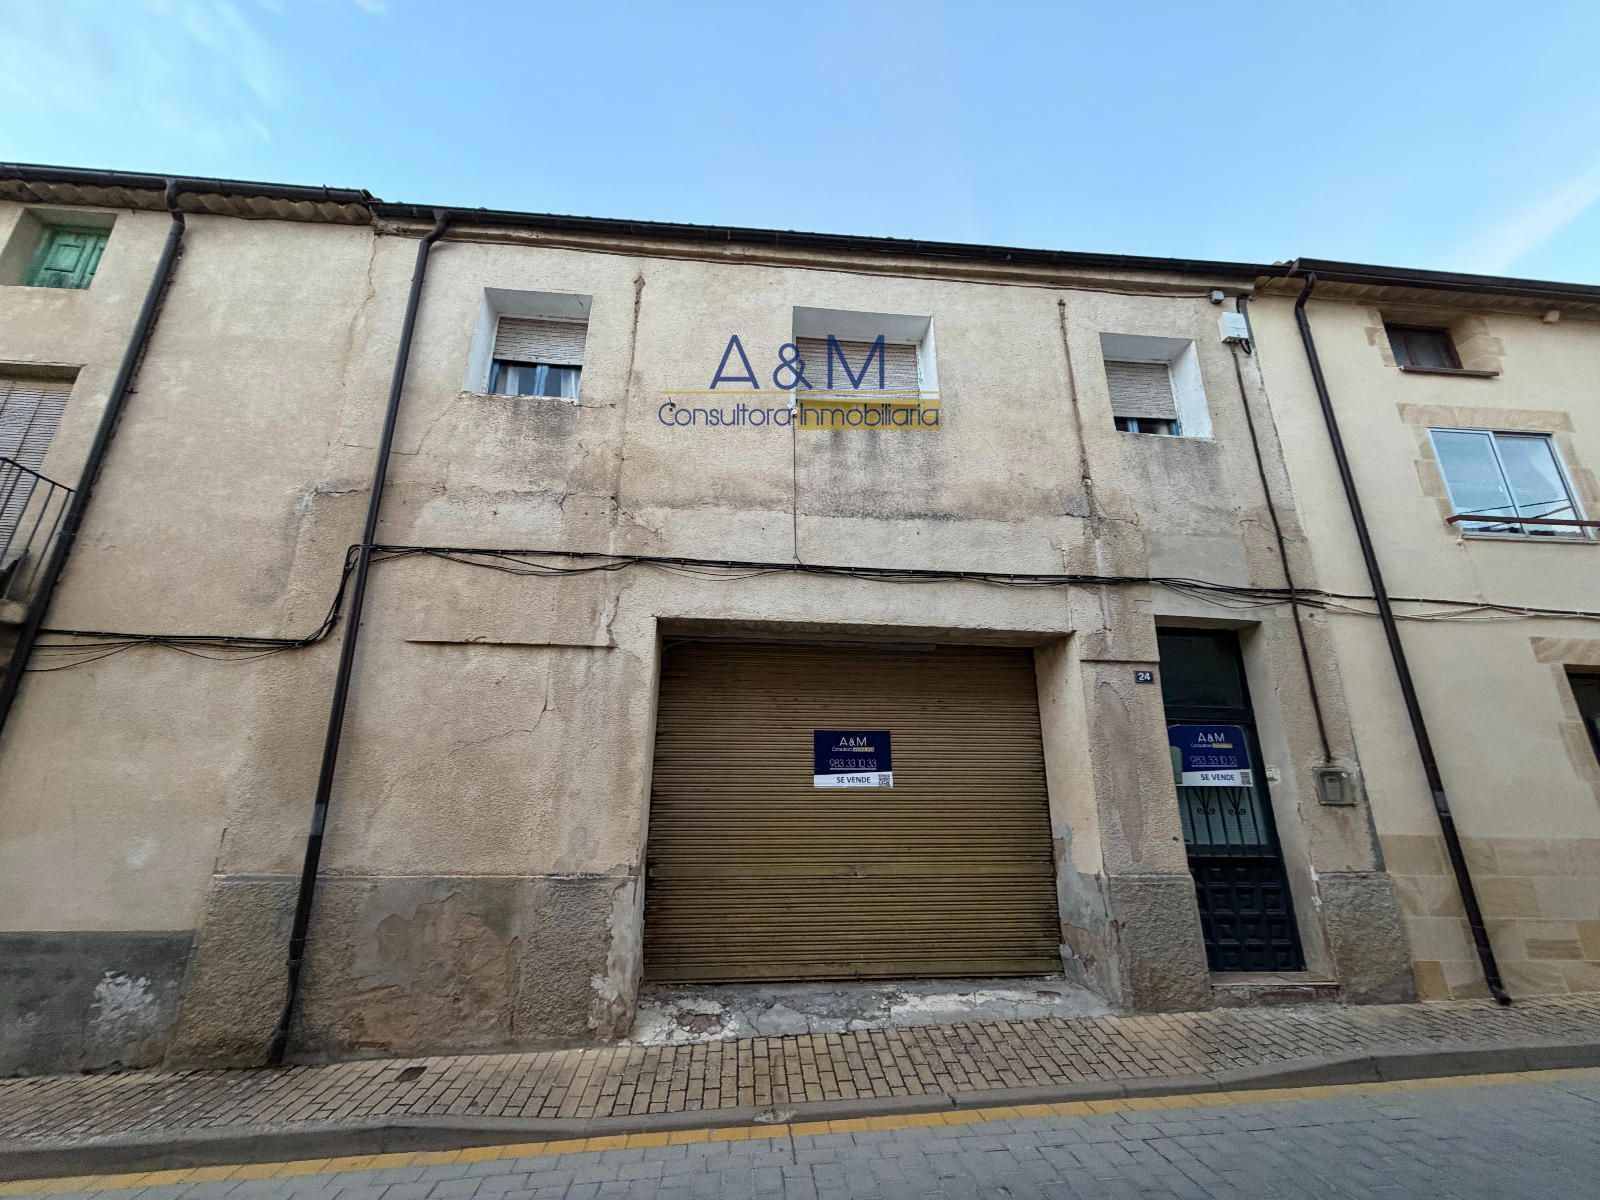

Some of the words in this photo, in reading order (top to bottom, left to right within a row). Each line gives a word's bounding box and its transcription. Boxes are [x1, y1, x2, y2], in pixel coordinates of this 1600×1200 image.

[1138, 672, 1151, 681] 24
[829, 758, 844, 768] 983
[846, 758, 856, 768] 33
[858, 758, 866, 768] 10
[867, 758, 877, 768] 33
[1189, 755, 1206, 765] 983
[1208, 755, 1218, 765] 33
[1200, 773, 1210, 781] SE
[1211, 773, 1235, 781] VENDE
